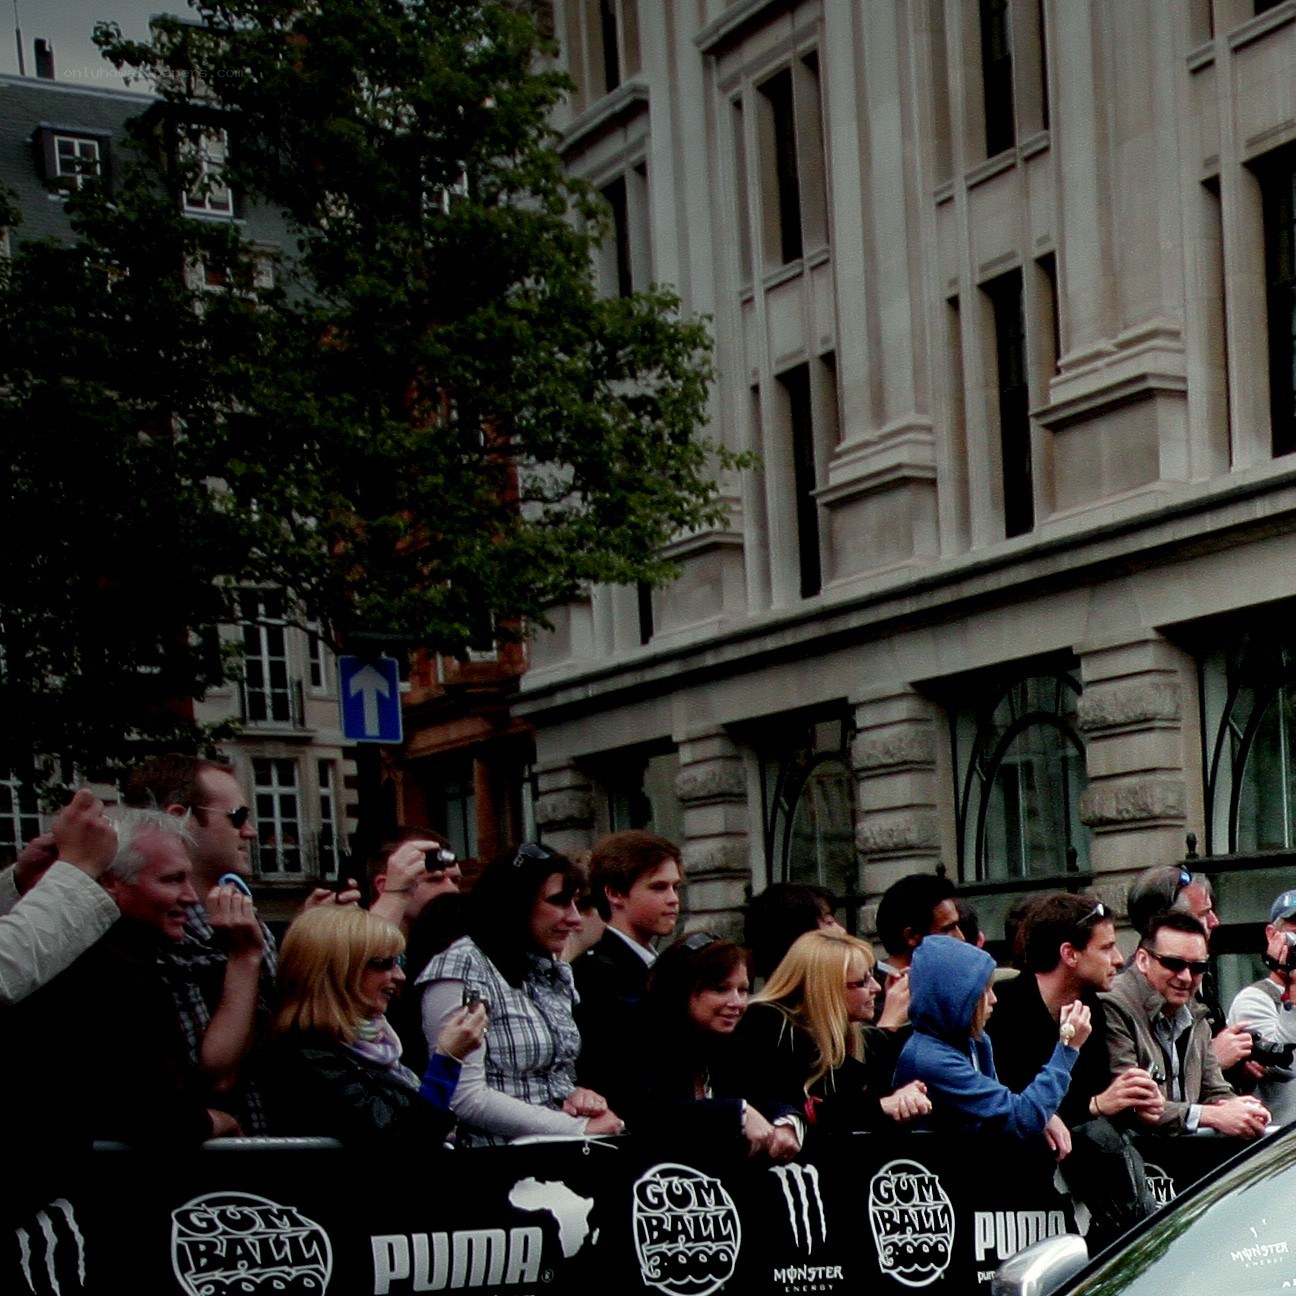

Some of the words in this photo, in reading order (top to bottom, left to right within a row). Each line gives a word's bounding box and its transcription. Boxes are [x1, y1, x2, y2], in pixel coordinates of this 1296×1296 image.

[634, 1174, 733, 1213] GUM
[870, 1172, 947, 1206] GUM
[172, 1204, 320, 1237] GUM
[636, 1208, 737, 1253] BALL
[872, 1205, 951, 1244] BALL
[176, 1230, 326, 1281] BALL
[370, 1226, 543, 1296] PUMA
[773, 1264, 843, 1285] MONSTER
